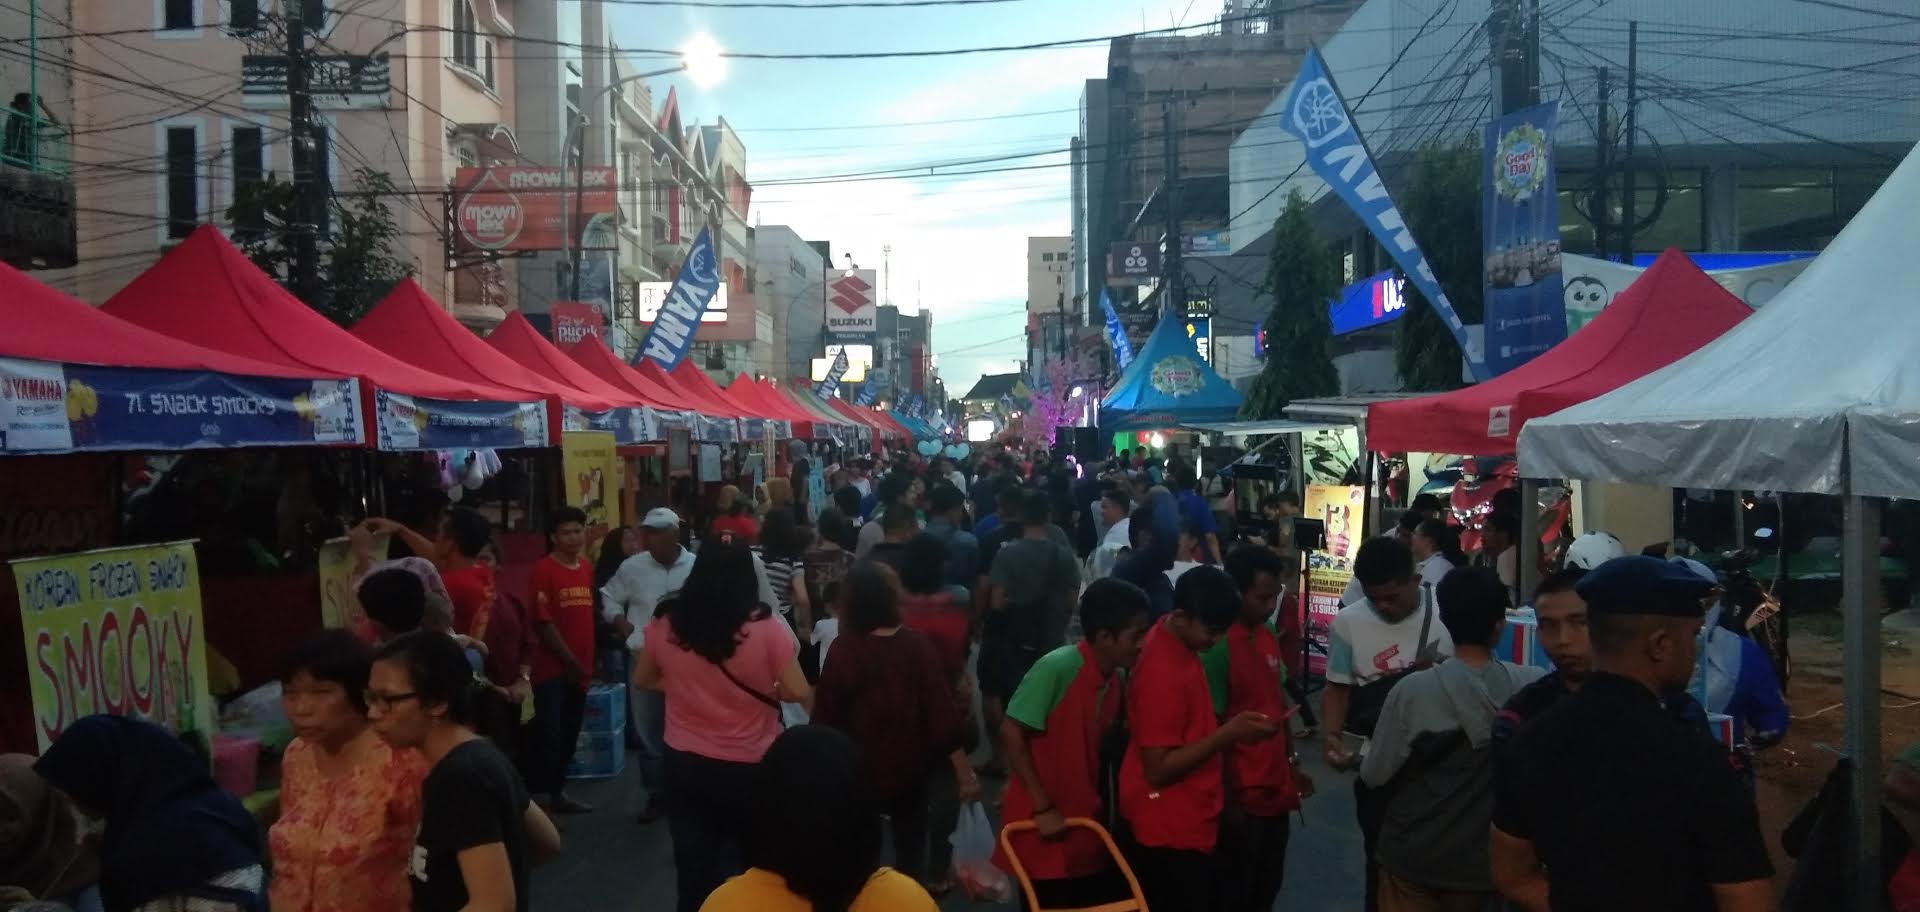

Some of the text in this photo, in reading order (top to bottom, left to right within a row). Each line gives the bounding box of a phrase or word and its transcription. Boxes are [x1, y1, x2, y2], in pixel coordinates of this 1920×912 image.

[1505, 149, 1537, 166] Good
[1509, 162, 1533, 176] Day
[829, 317, 873, 327] SUZUKI
[12, 377, 62, 401] YAMAHA
[125, 392, 145, 414] 71.
[89, 561, 141, 599] FROZEN
[36, 605, 193, 743] SMOOKY
